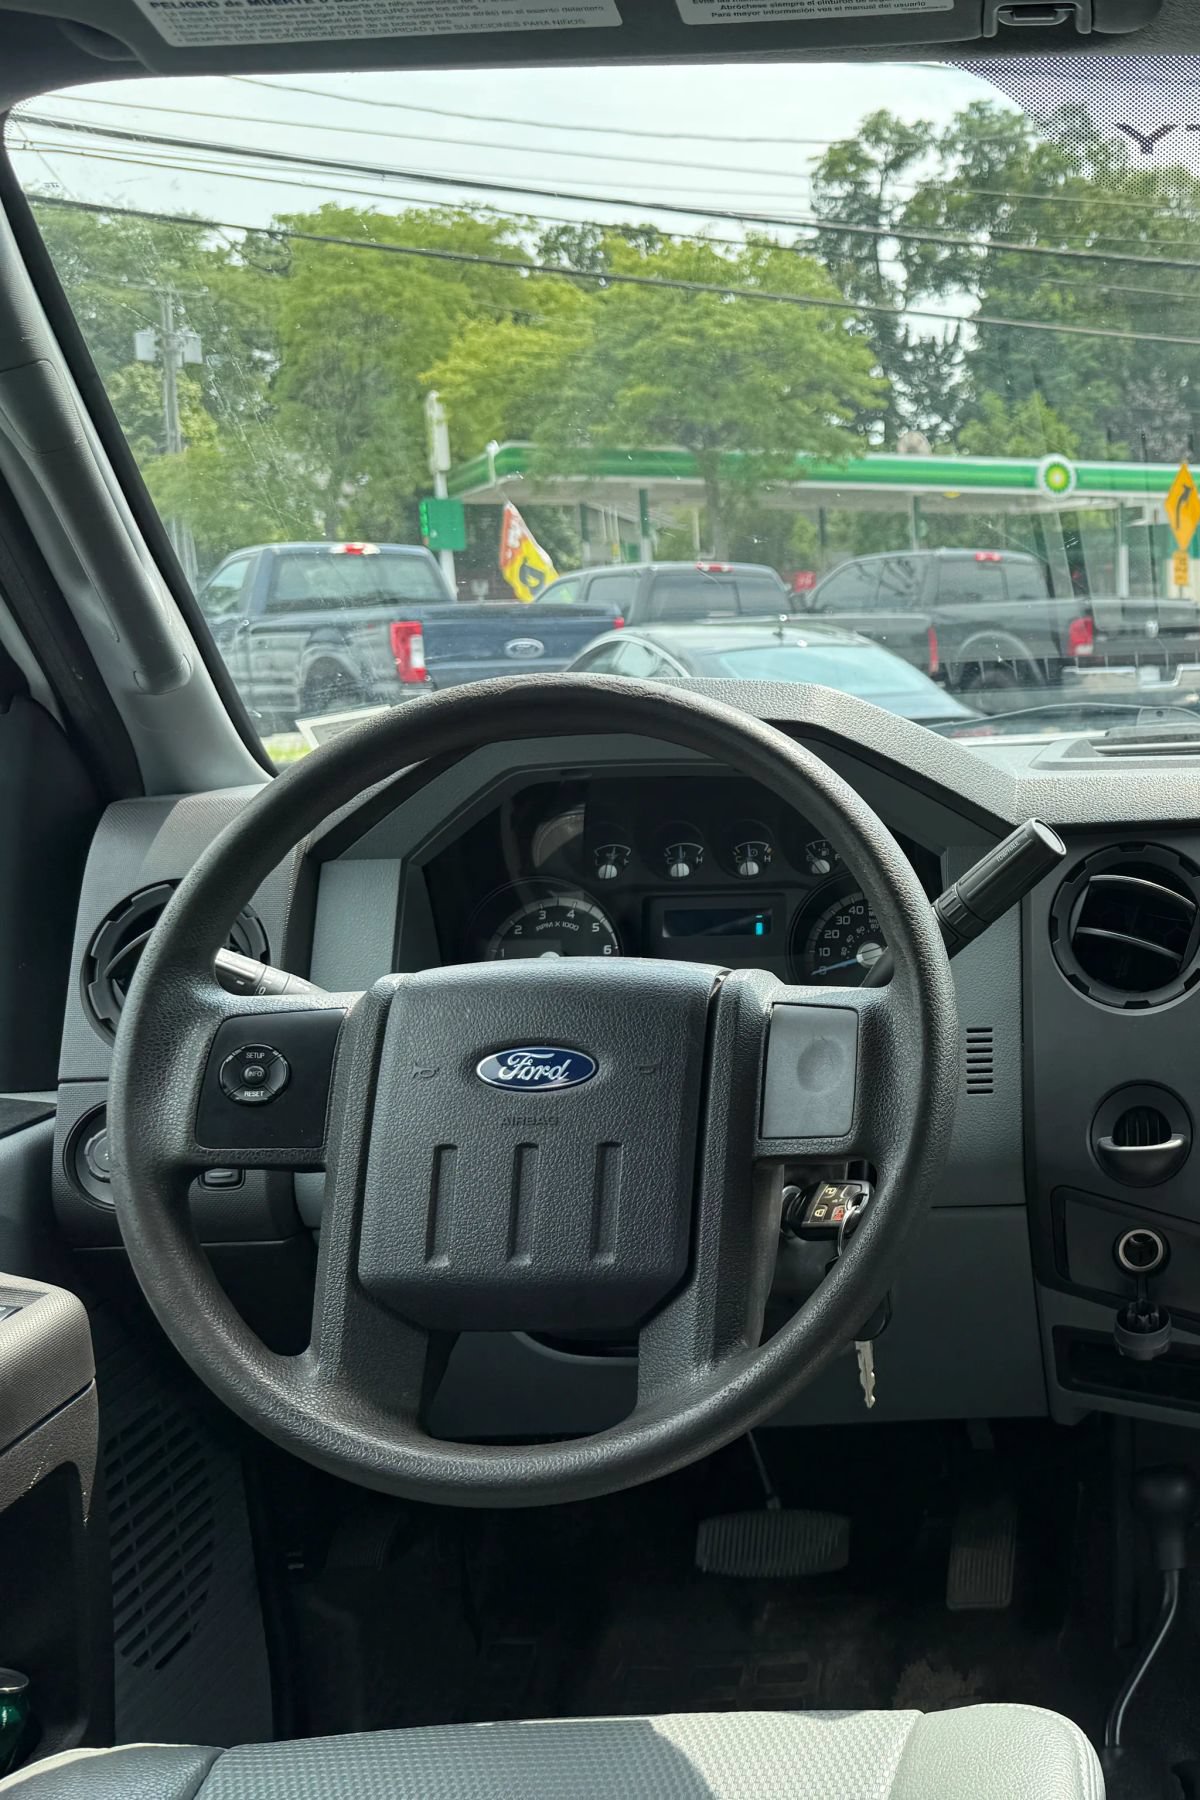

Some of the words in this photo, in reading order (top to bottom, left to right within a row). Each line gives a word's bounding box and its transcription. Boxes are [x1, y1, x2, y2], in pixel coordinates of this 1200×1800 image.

[538, 910, 547, 919] 3
[566, 909, 576, 919] 4
[849, 906, 865, 915] 40
[835, 916, 851, 925] 30
[514, 925, 523, 935] 2
[562, 921, 580, 932] 1000
[592, 922, 600, 932] 5
[824, 930, 840, 939] 20
[603, 944, 612, 954] 6
[818, 948, 831, 957] 10
[498, 1052, 572, 1081] Ford
